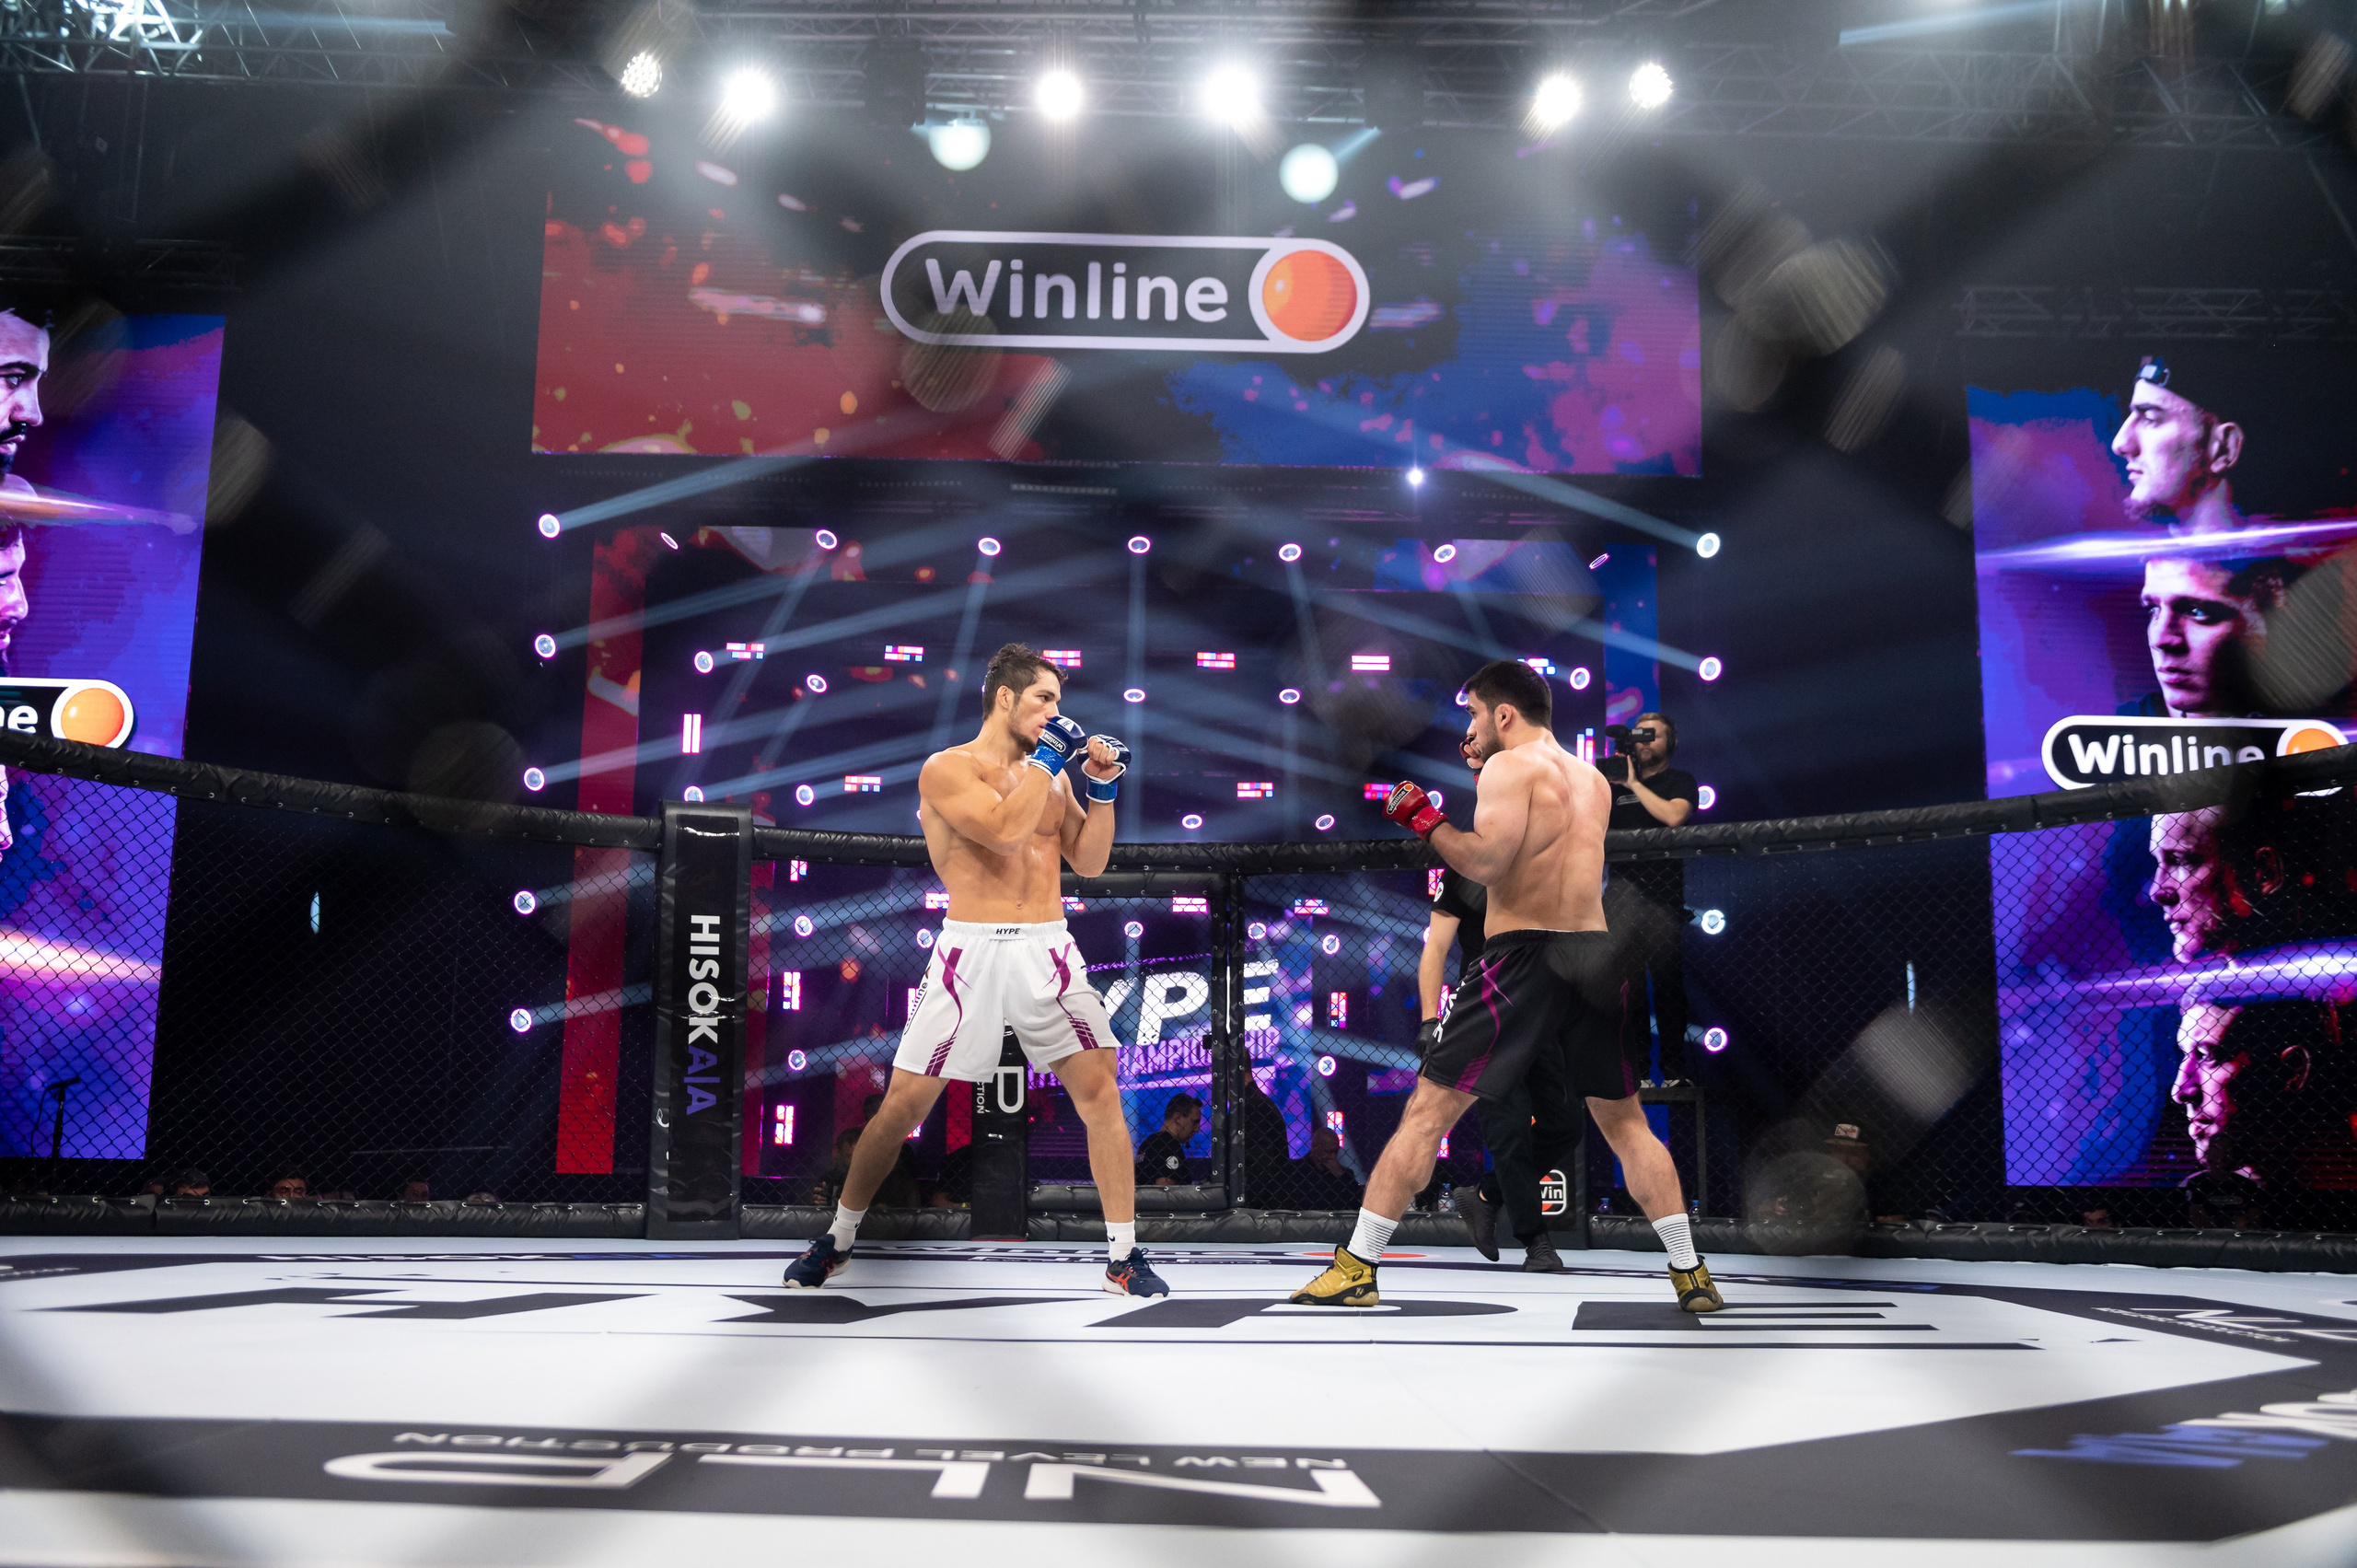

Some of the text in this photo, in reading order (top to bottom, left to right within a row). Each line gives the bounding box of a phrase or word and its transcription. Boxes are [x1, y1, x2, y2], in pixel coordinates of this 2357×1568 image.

[925, 258, 1228, 322] Winline
[1389, 790, 1406, 811] Winline
[995, 927, 1021, 935] HYPE
